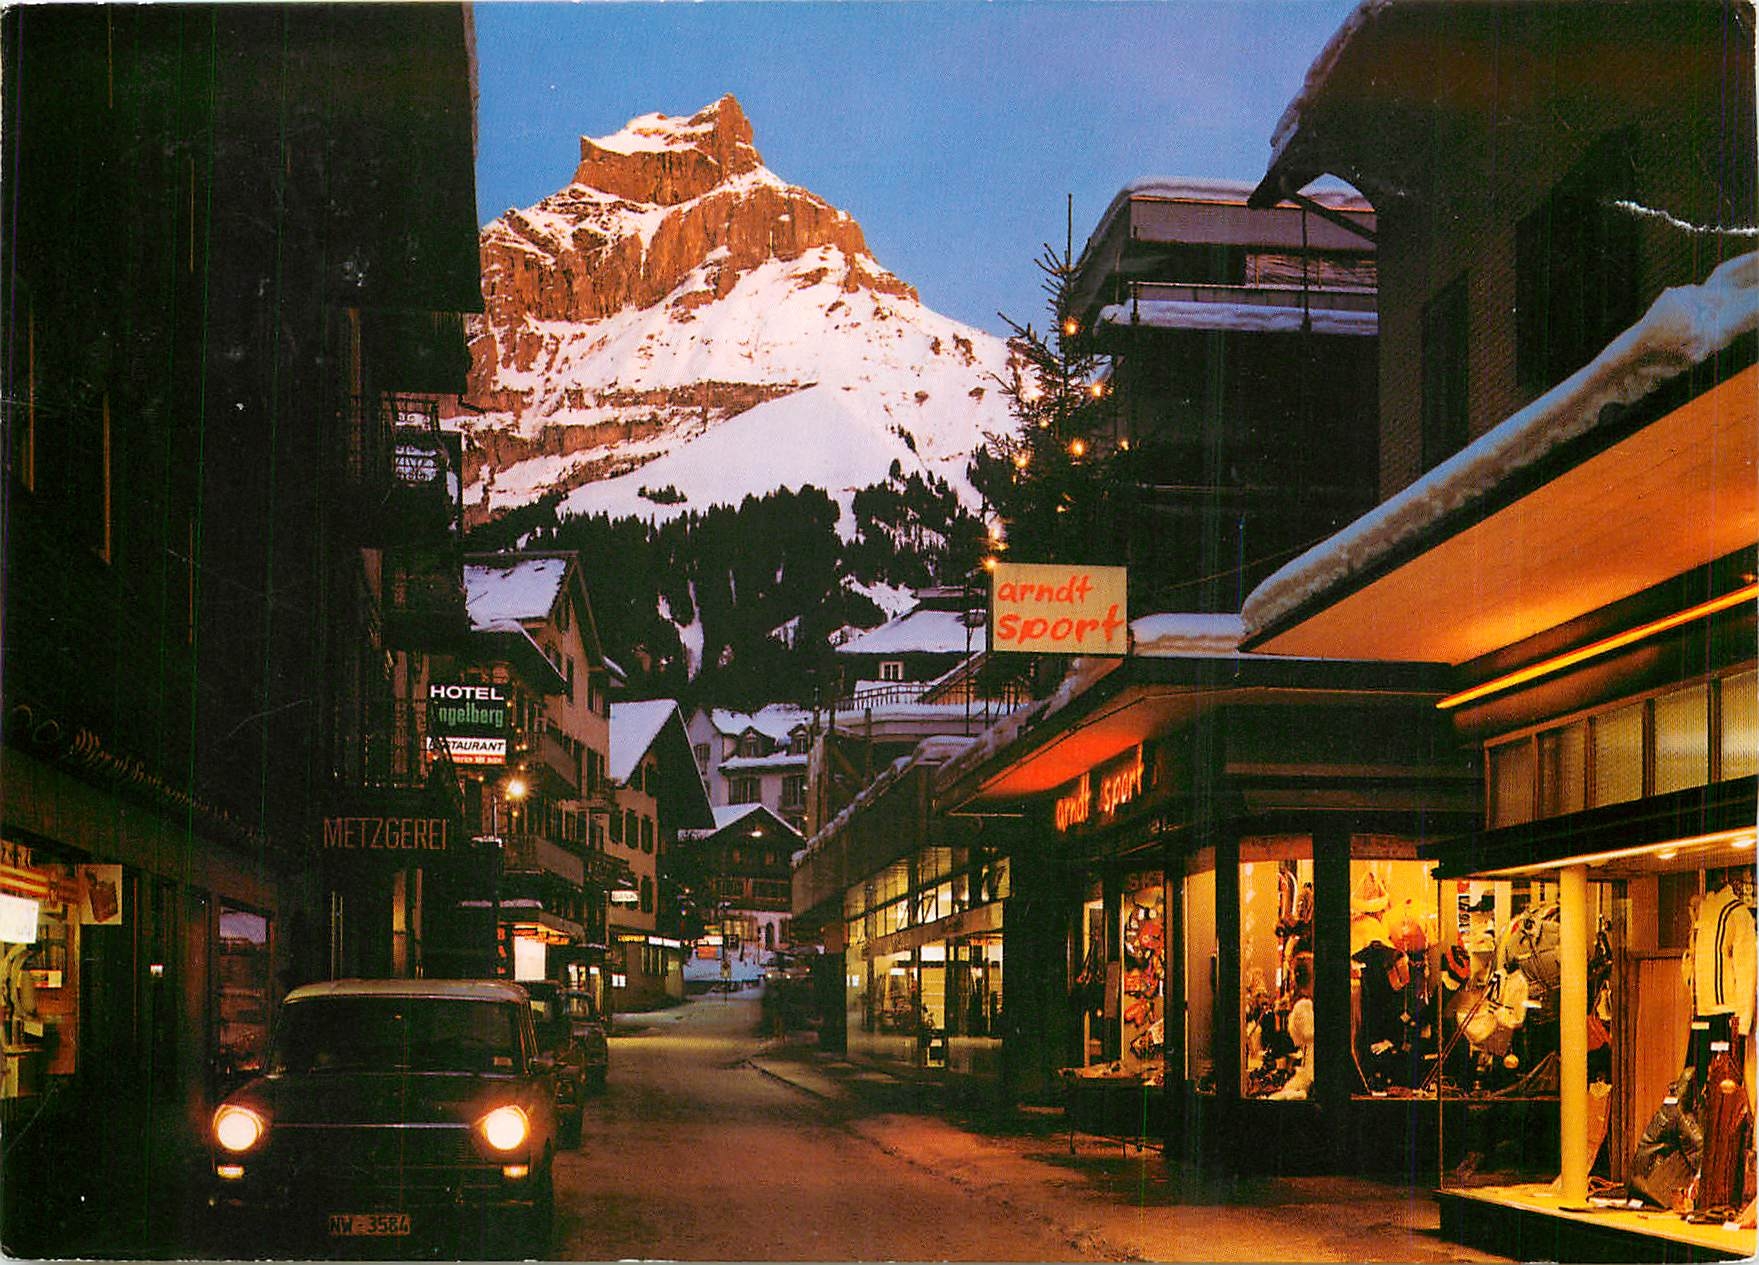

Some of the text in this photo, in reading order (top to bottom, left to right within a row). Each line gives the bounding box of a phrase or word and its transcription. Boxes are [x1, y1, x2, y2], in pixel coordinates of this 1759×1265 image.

[997, 576, 1093, 603] arndt
[996, 604, 1125, 644] sport
[430, 685, 504, 701] HOTEL
[431, 701, 504, 728] ngelberg
[429, 740, 505, 752] TAURANT
[1055, 742, 1145, 833] arndt sport
[322, 816, 448, 850] METZGEREI
